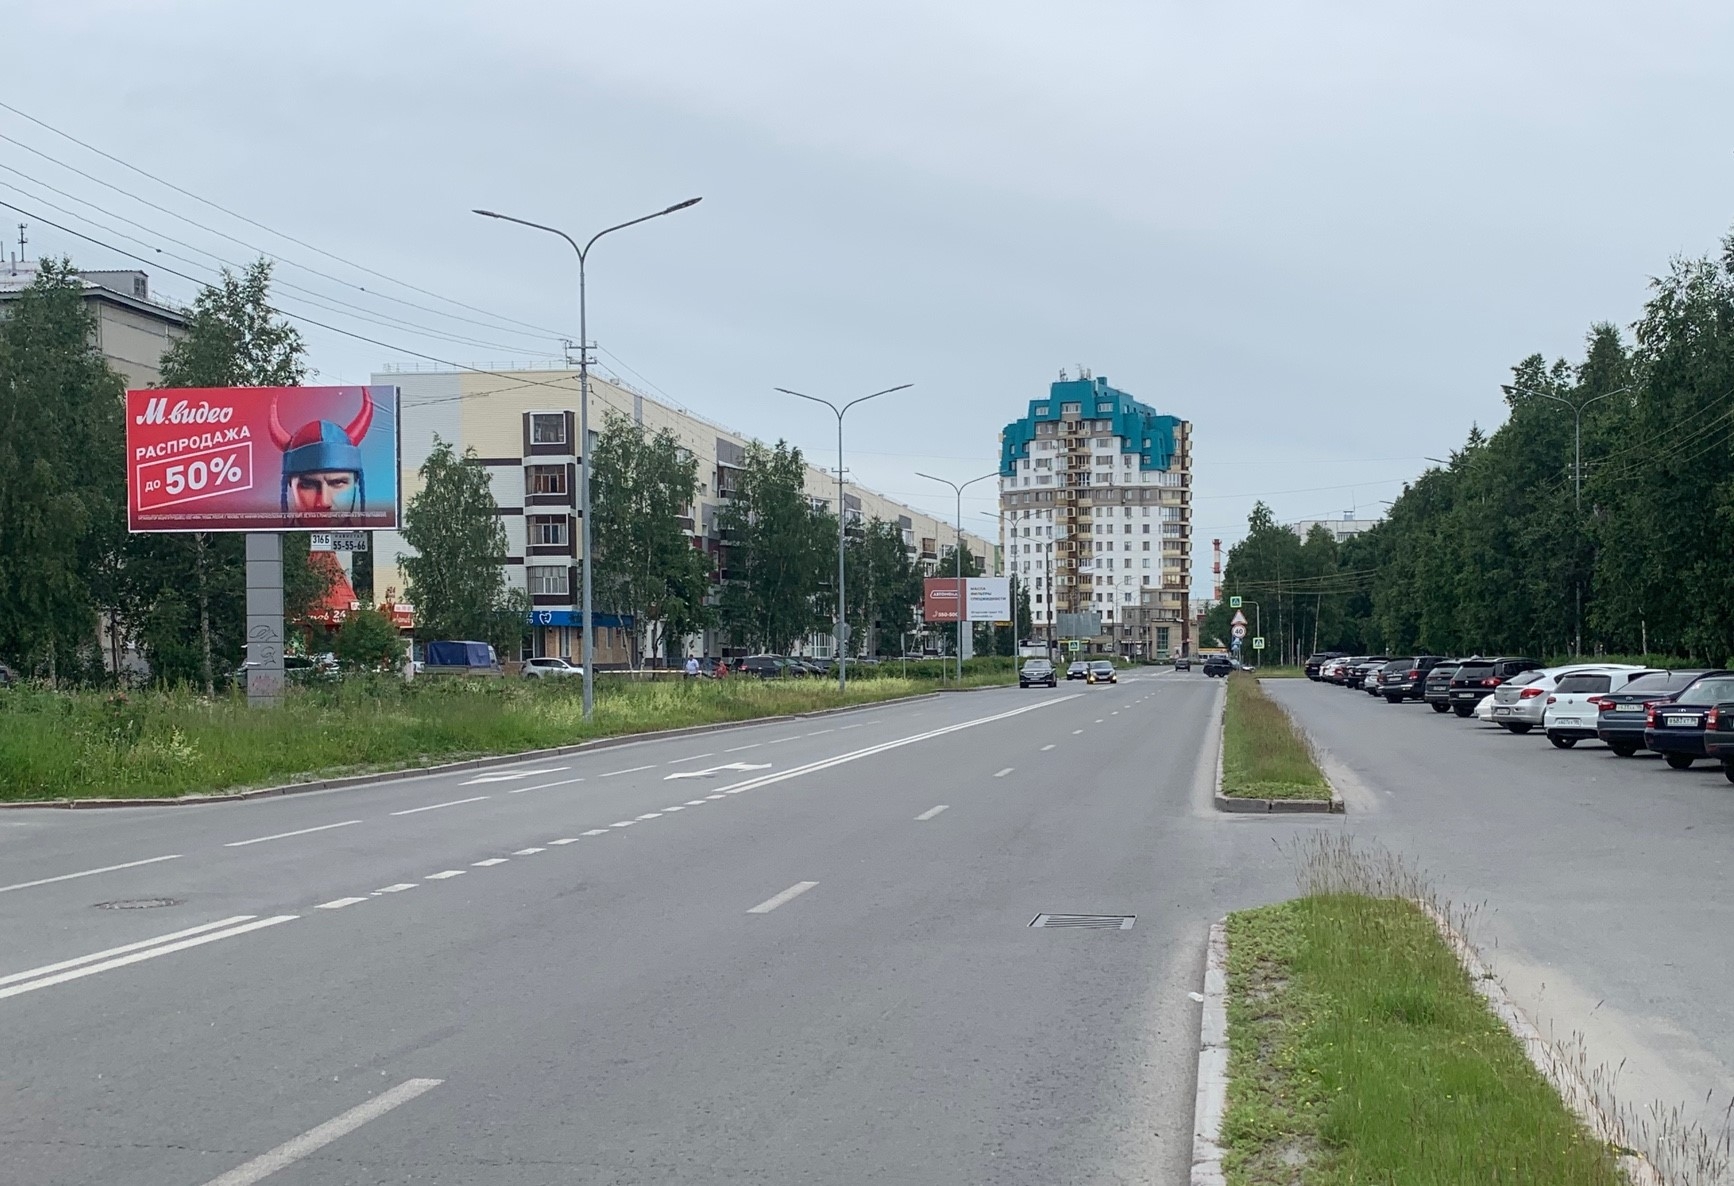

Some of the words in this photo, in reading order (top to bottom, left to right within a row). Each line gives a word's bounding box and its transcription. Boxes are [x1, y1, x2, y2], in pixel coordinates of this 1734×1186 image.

[136, 398, 233, 425] М.видео
[136, 426, 251, 461] РАСПРОДАЖА
[165, 454, 242, 495] 50%
[333, 540, 366, 550] 55-55-66
